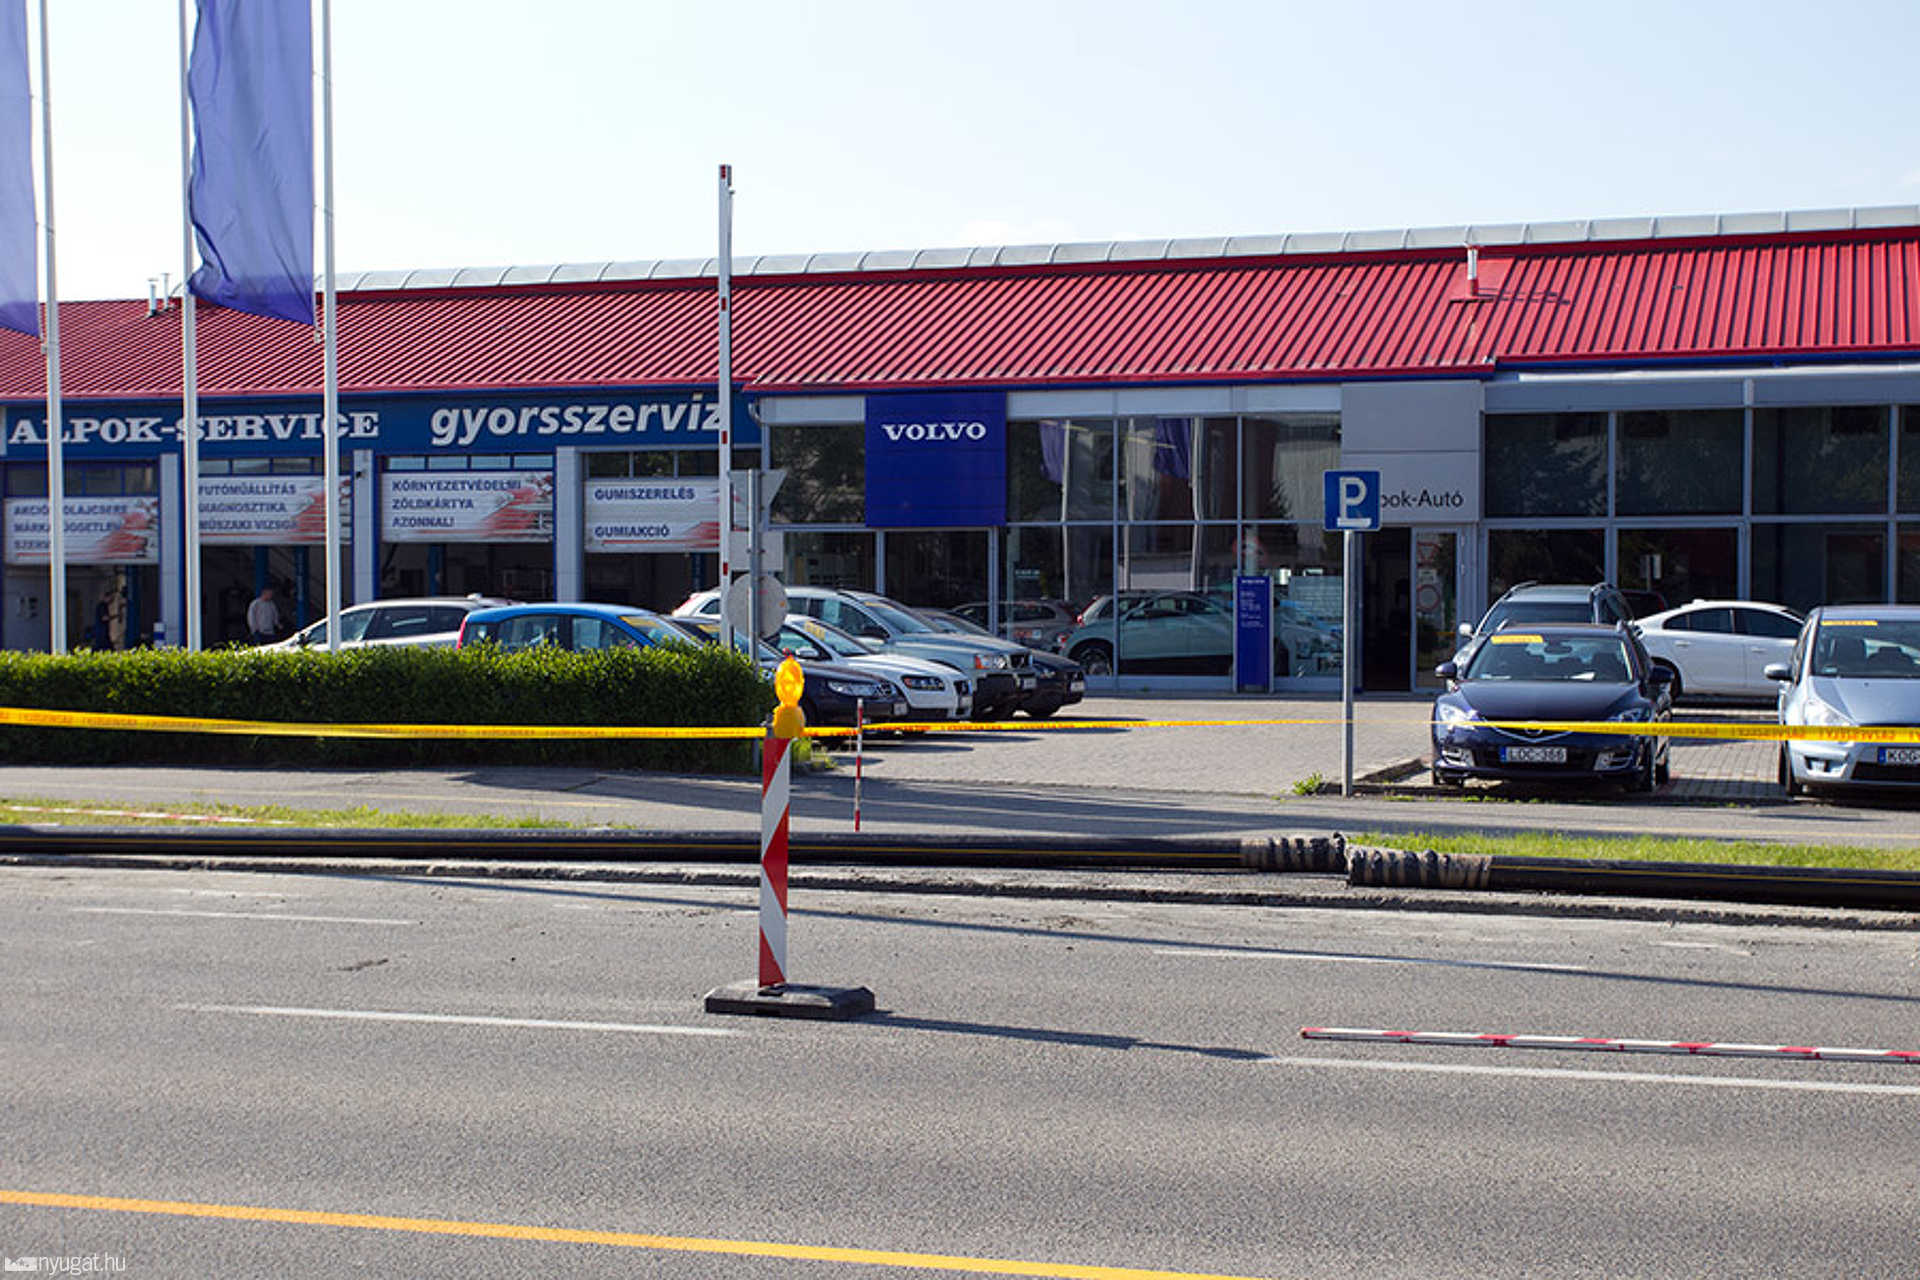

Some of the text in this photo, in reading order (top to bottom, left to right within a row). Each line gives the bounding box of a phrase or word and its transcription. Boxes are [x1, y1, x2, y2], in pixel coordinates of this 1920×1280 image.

[430, 394, 720, 446] gyorsszerviz
[881, 422, 987, 441] VOLVO
[594, 487, 696, 500] GUMISZERELÉS
[1338, 476, 1368, 521] P
[392, 498, 474, 509] ZÖLDKÁRTYA
[594, 524, 670, 537] GUMIAKCIÓ
